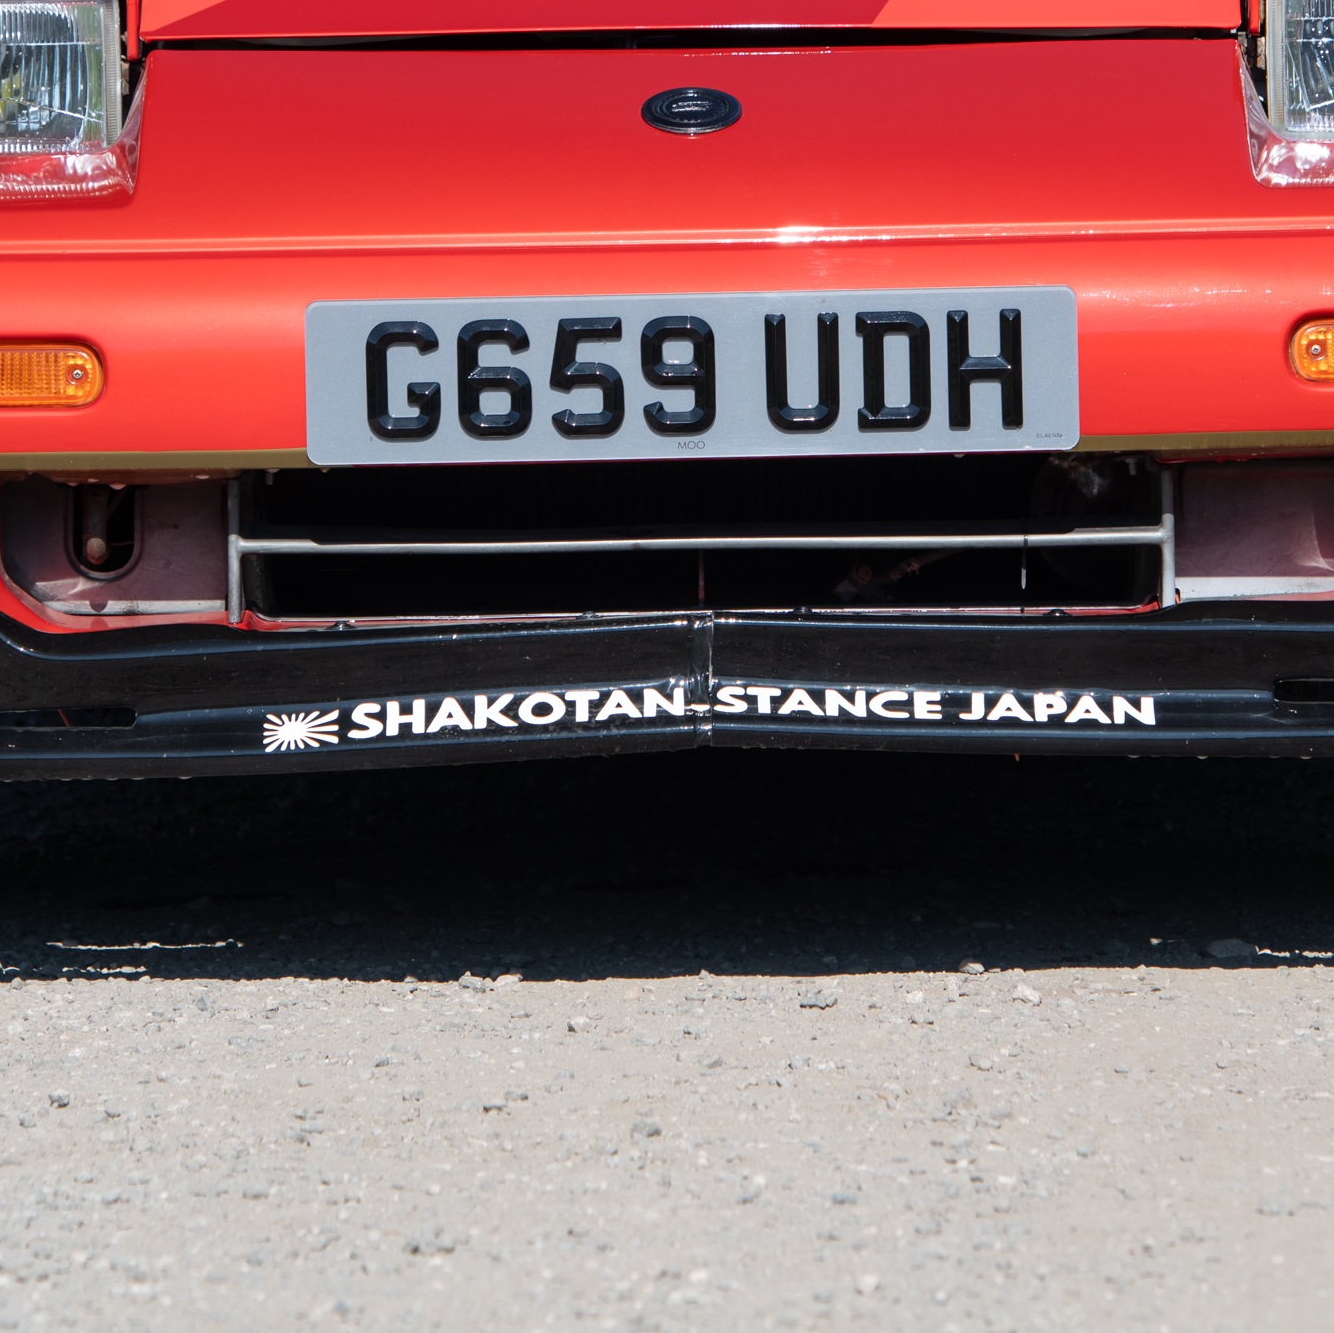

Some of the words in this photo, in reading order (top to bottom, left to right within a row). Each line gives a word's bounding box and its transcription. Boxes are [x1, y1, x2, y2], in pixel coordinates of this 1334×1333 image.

[365, 315, 716, 440] G659
[765, 309, 1023, 435] UDH
[677, 440, 706, 450] MOO
[347, 687, 685, 740] SHAKOTAN
[715, 686, 943, 720] STANCE
[958, 693, 1157, 726] JAPAN
